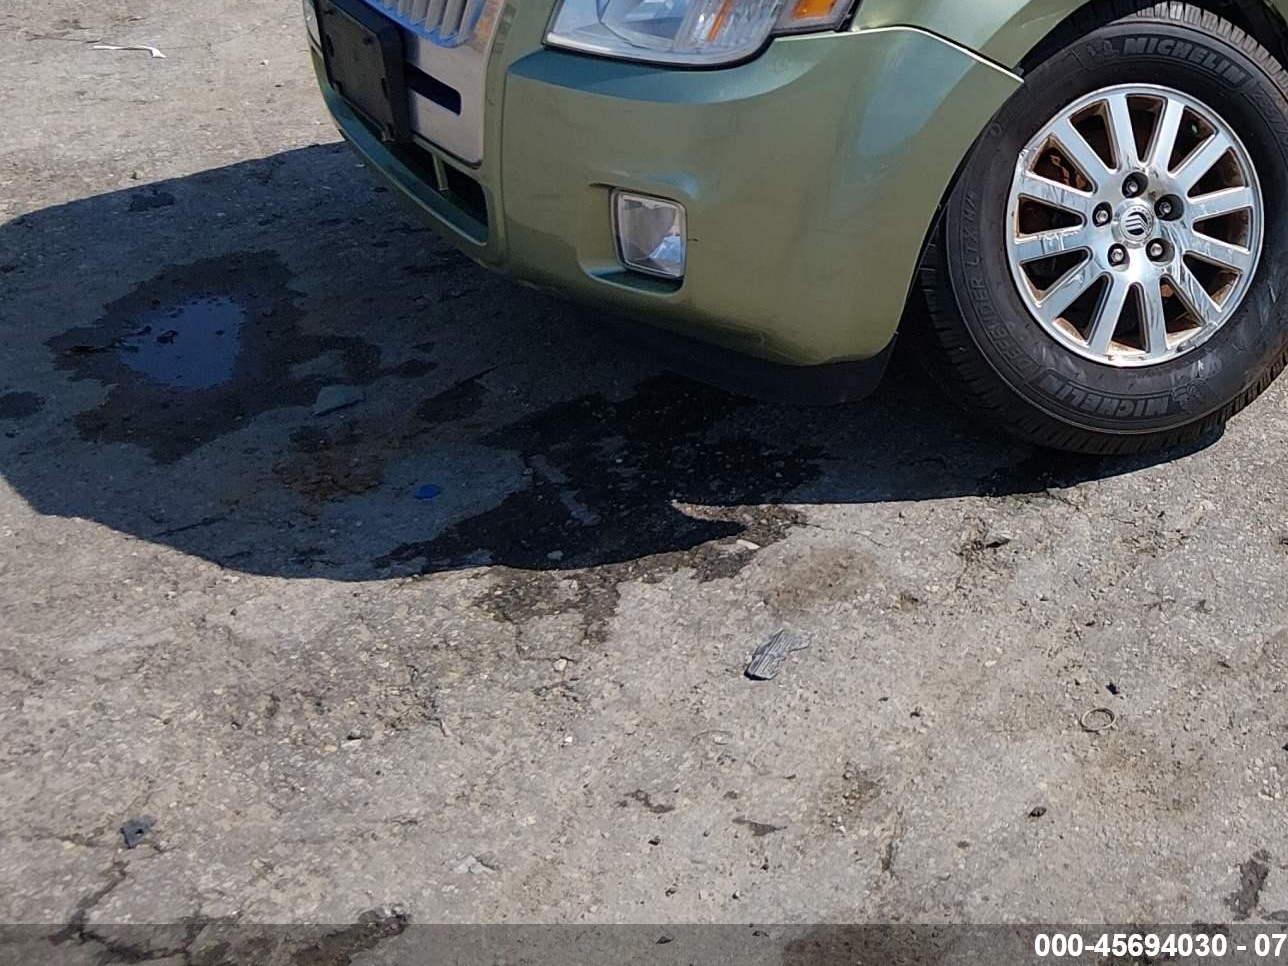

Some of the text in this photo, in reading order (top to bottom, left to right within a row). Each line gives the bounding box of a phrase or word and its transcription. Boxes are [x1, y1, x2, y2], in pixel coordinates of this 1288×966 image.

[1123, 37, 1248, 85] MICHELIN
[963, 227, 981, 267] LTX
[970, 276, 1033, 371] DEFENDER
[1039, 375, 1169, 417] MICHELIN
